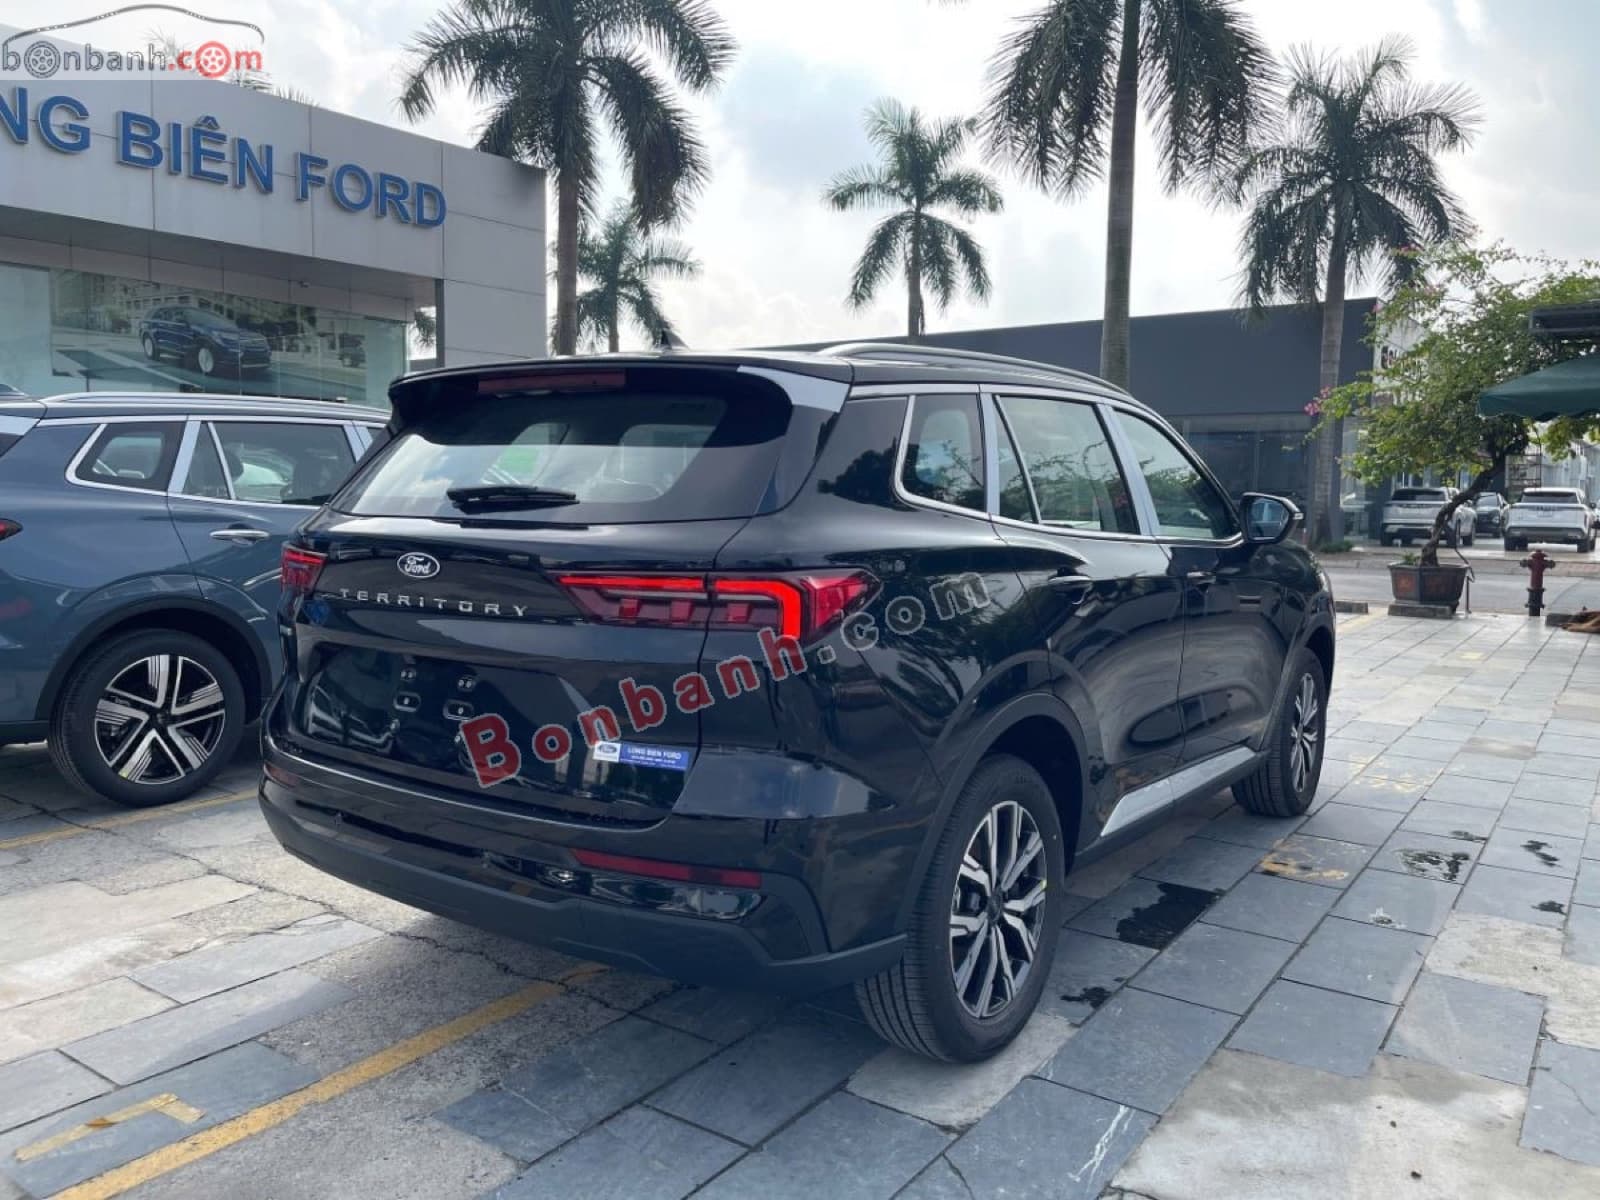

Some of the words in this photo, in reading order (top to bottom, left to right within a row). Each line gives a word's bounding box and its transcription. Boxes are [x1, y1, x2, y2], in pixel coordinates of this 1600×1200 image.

[116, 110, 273, 194] BIÊN
[296, 151, 447, 228] FORD
[339, 588, 528, 617] TERRITORY
